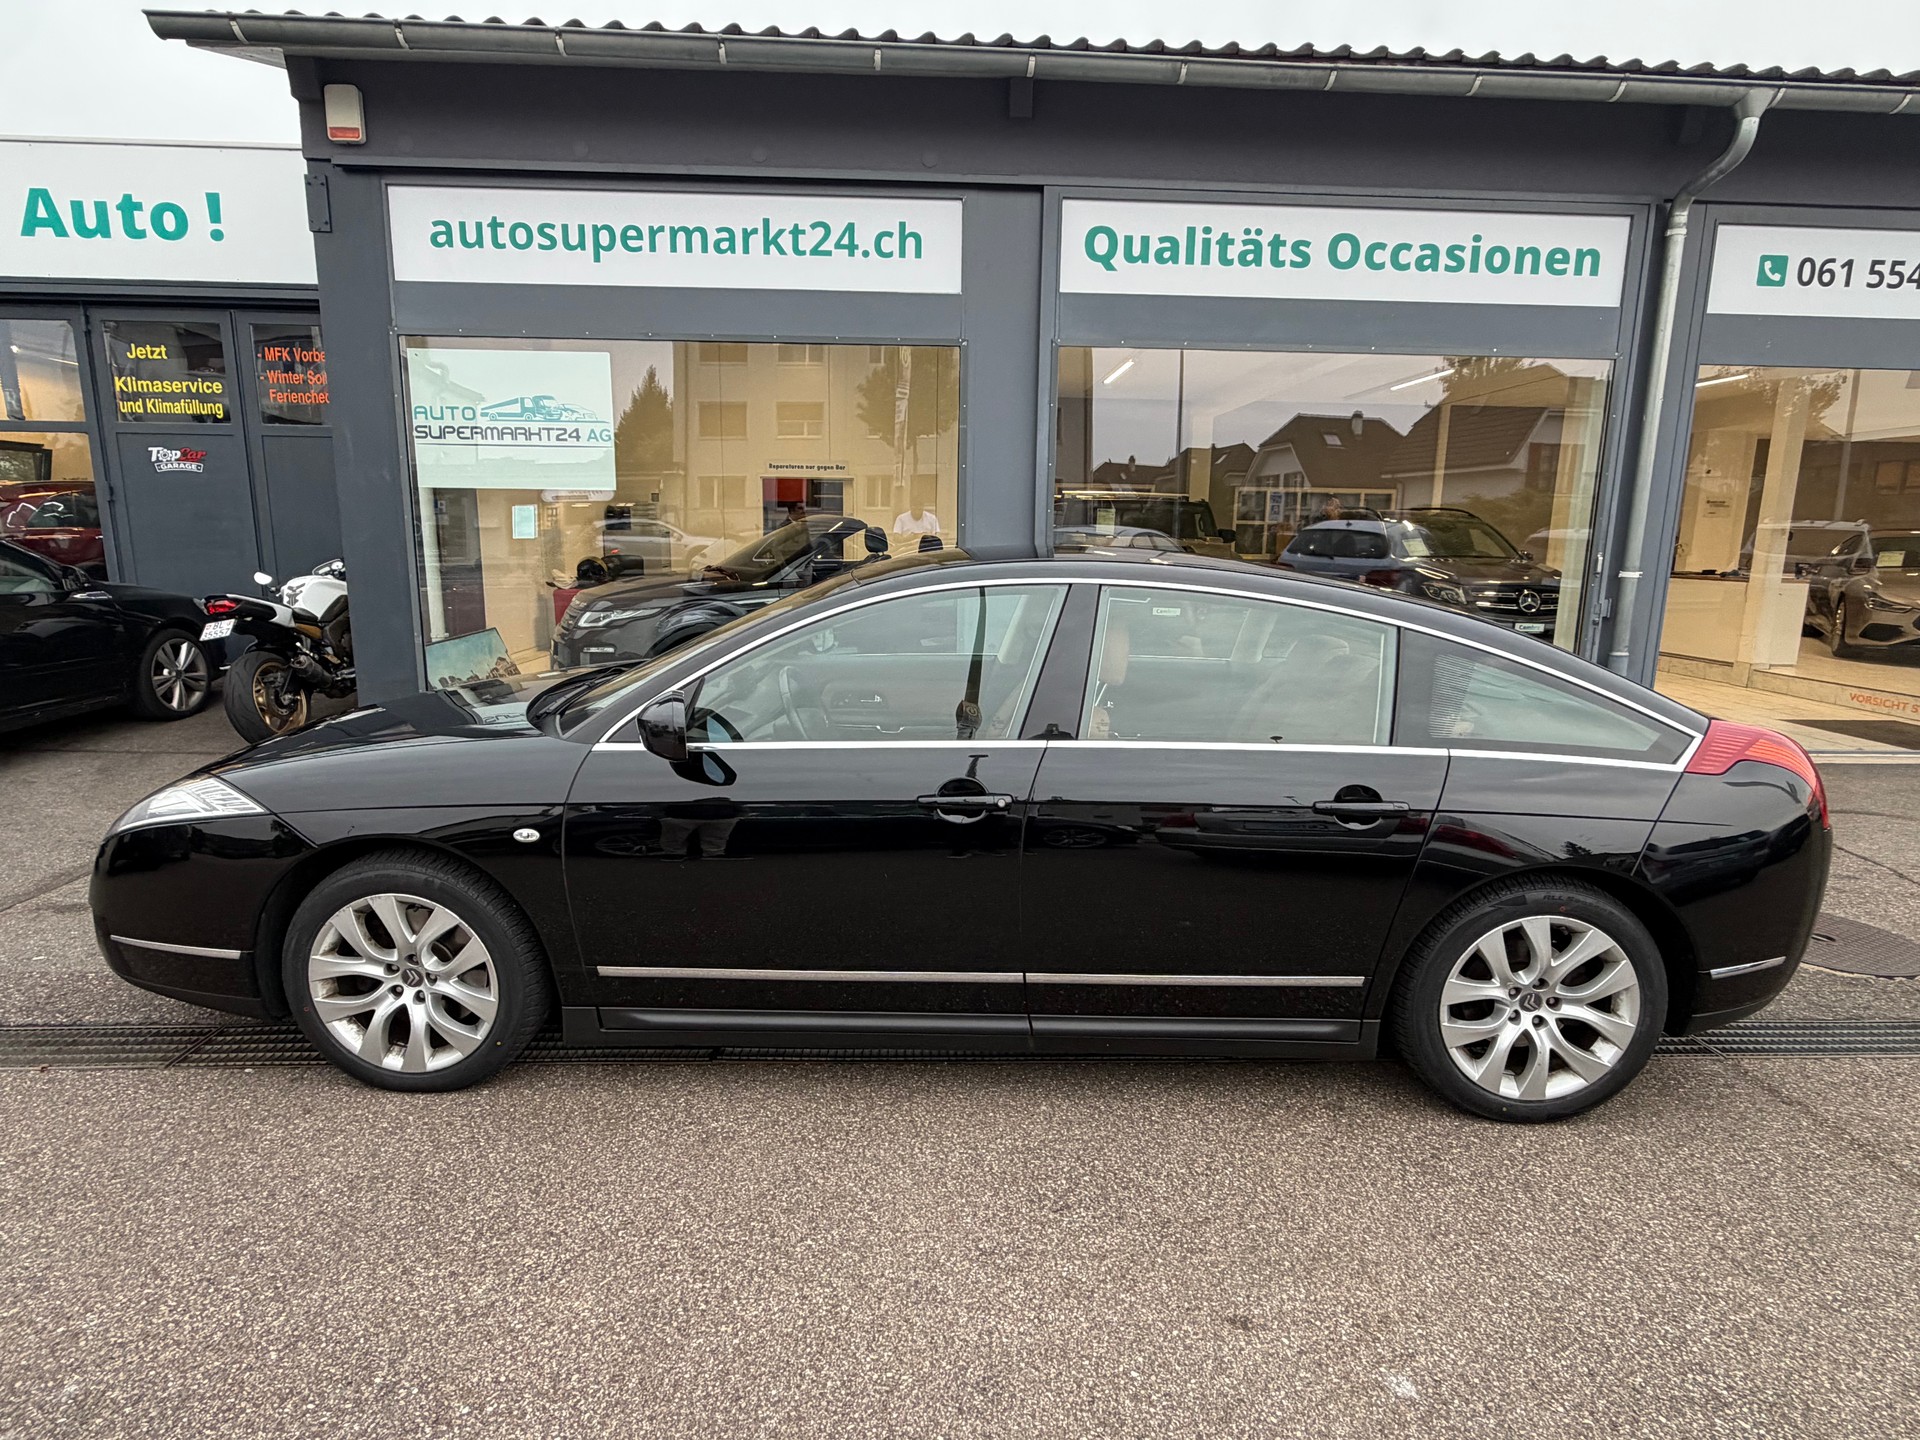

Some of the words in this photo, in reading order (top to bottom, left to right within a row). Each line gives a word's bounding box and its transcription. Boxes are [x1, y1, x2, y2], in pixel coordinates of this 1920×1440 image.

[20, 187, 189, 242] Auto
[429, 214, 923, 263] autosupermarkt24.ch
[1084, 225, 1312, 272] Qualitäts
[1327, 232, 1601, 277] Occasionen
[1797, 257, 1854, 288] 061
[1866, 260, 1920, 289] 554
[126, 343, 168, 359] Jetzt
[264, 347, 291, 362] MFK
[114, 376, 223, 394] Klimaservice
[266, 369, 304, 385] Winter
[119, 398, 144, 413] und
[146, 398, 224, 419] Klimafüllung
[414, 405, 476, 421] AUTO
[414, 425, 581, 442] SUPERMARKT24
[587, 428, 612, 442] AG
[1849, 692, 1909, 711] VORSICHT
